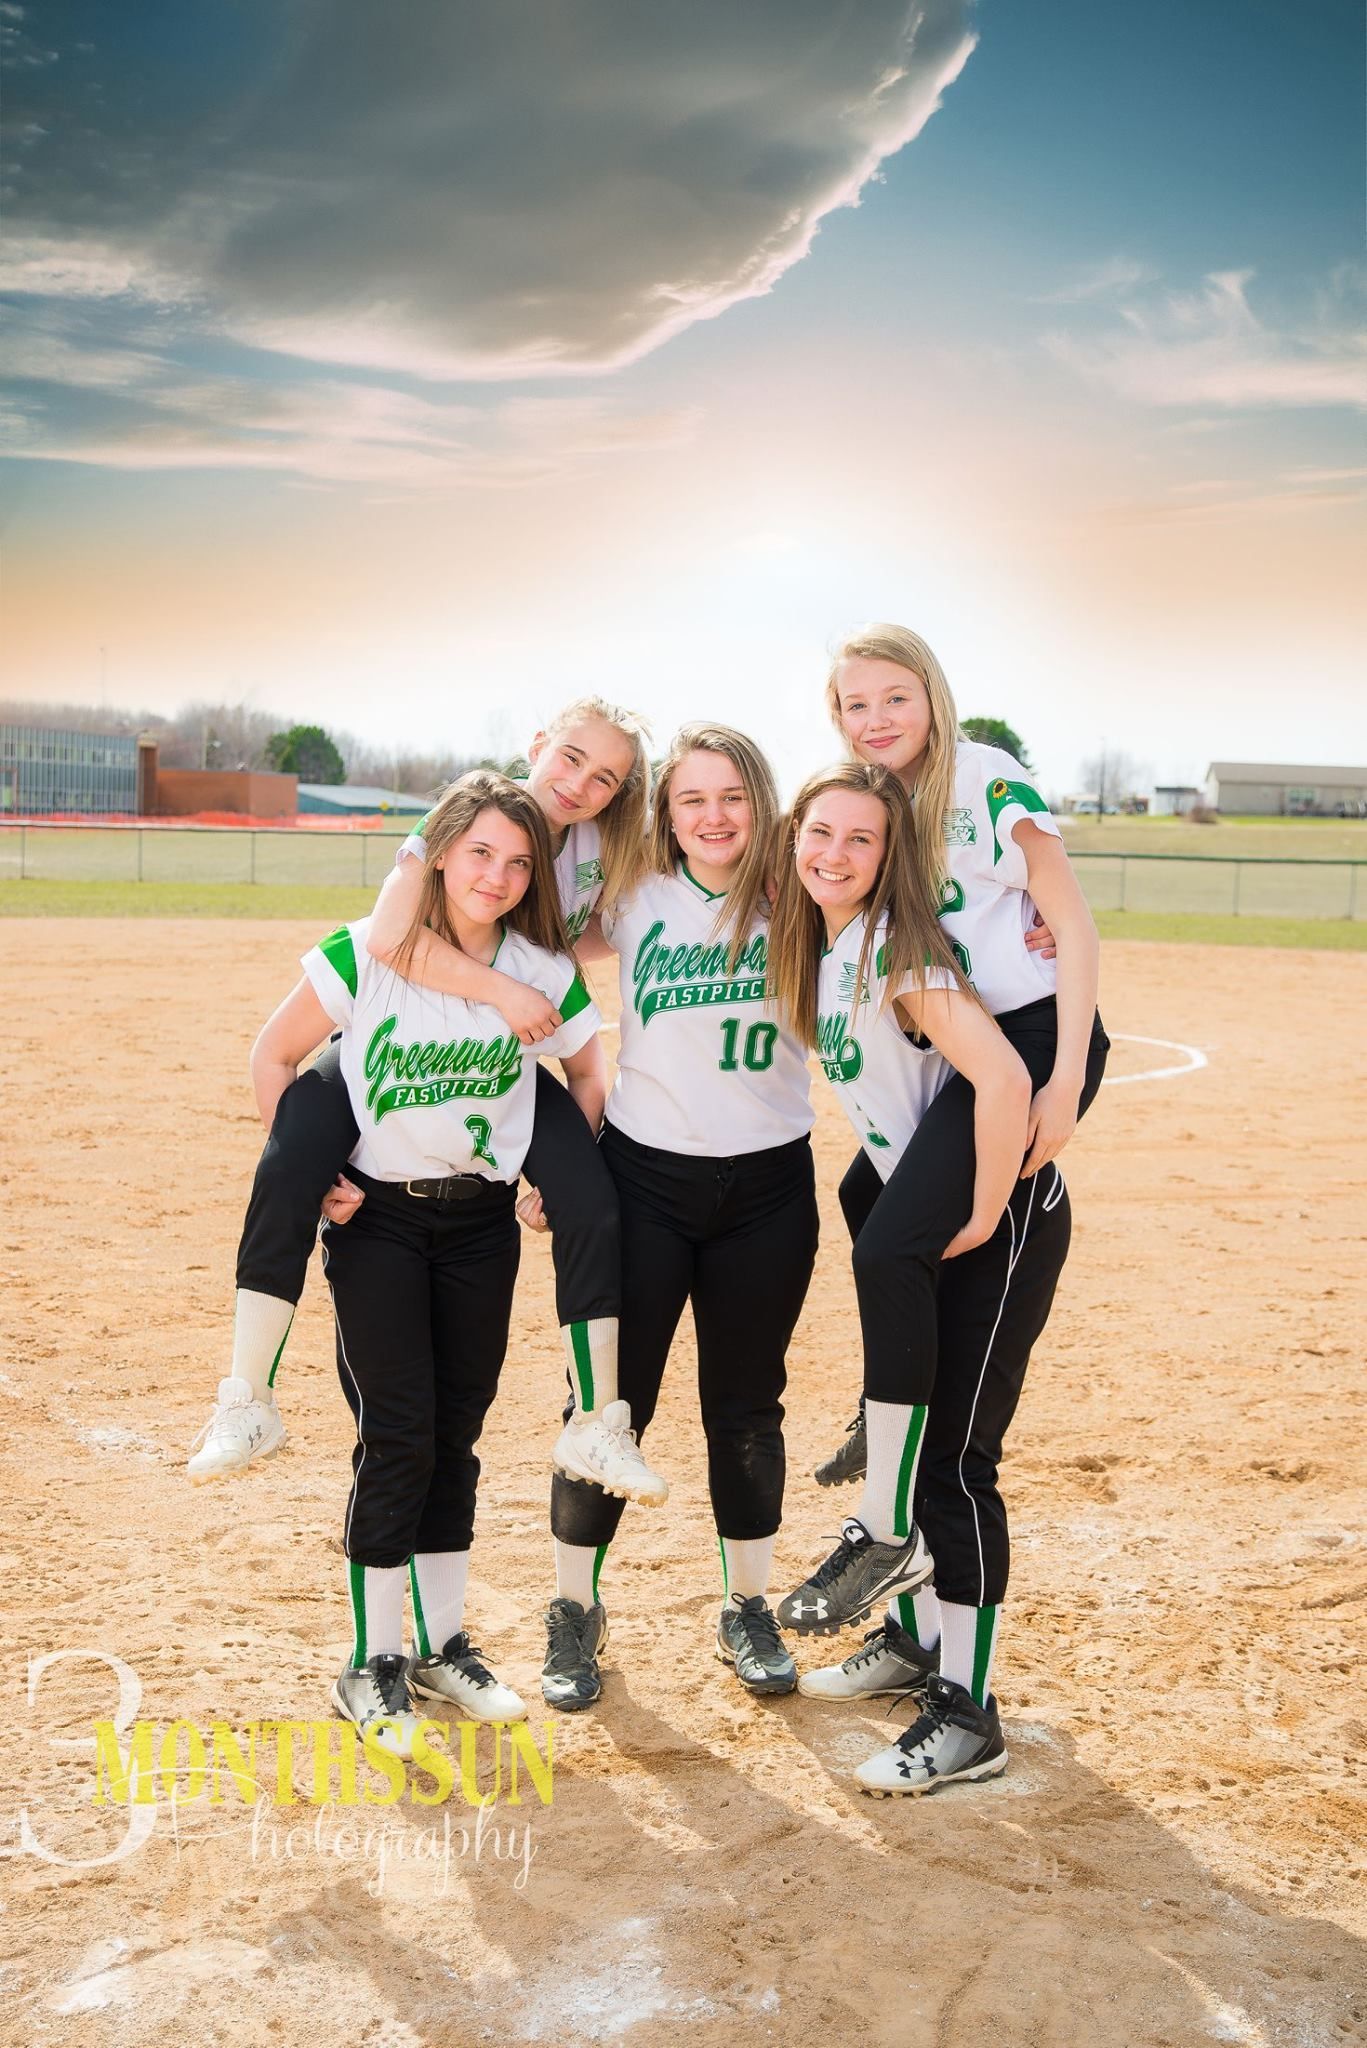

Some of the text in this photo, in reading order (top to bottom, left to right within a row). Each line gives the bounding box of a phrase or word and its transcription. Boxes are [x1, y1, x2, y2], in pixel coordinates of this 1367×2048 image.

[632, 920, 769, 1014] Greenwa
[655, 980, 774, 1009] FASTPITC
[364, 1013, 521, 1110] Greenway
[718, 1017, 780, 1072] 10
[393, 1077, 500, 1107] FASTPITCH
[464, 1114, 498, 1169] 2
